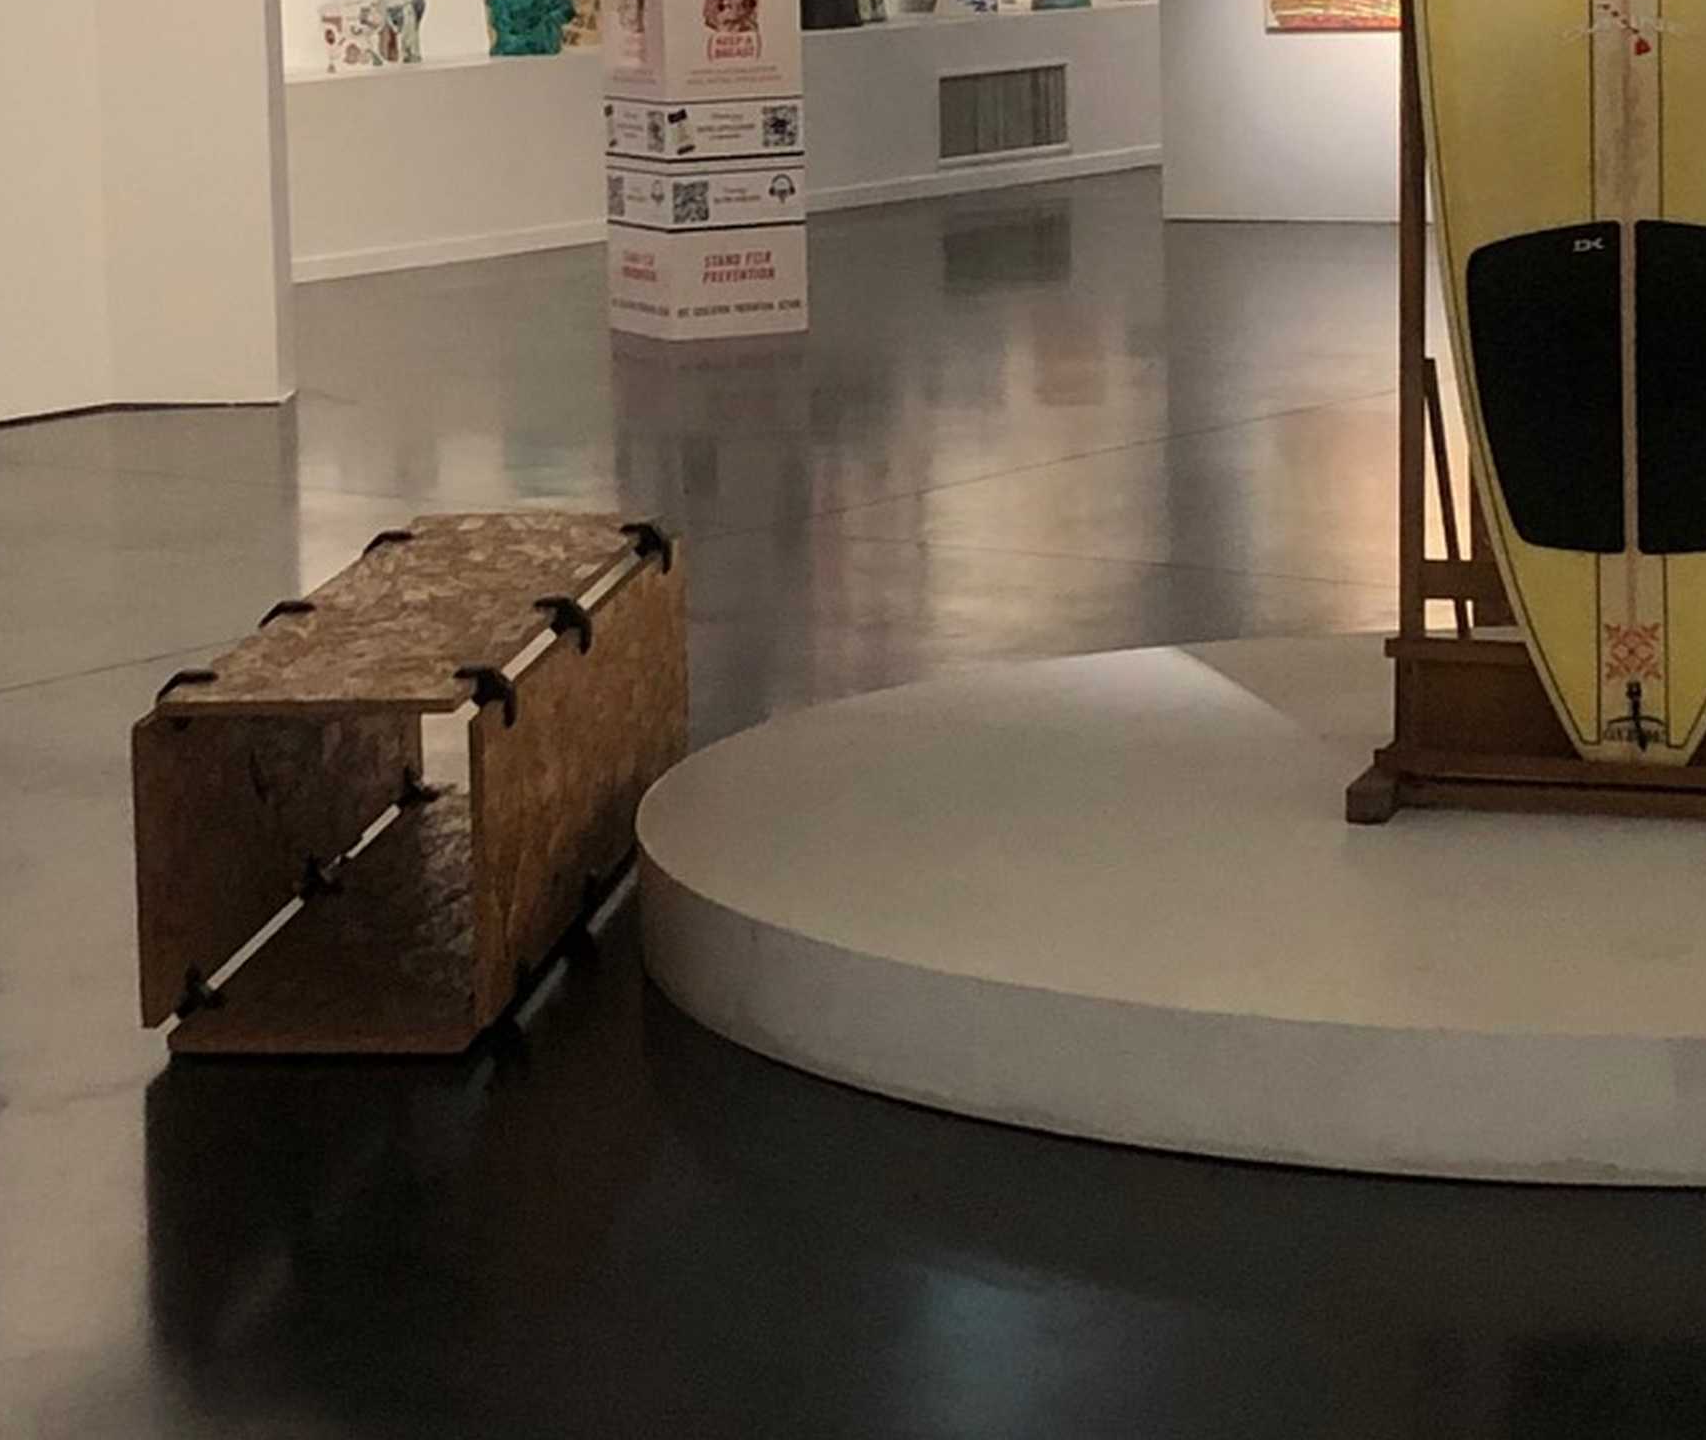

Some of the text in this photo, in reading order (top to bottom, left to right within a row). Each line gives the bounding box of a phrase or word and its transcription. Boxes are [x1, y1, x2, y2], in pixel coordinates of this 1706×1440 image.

[704, 251, 772, 268] STAND FOR
[702, 268, 775, 285] PREVENTION
